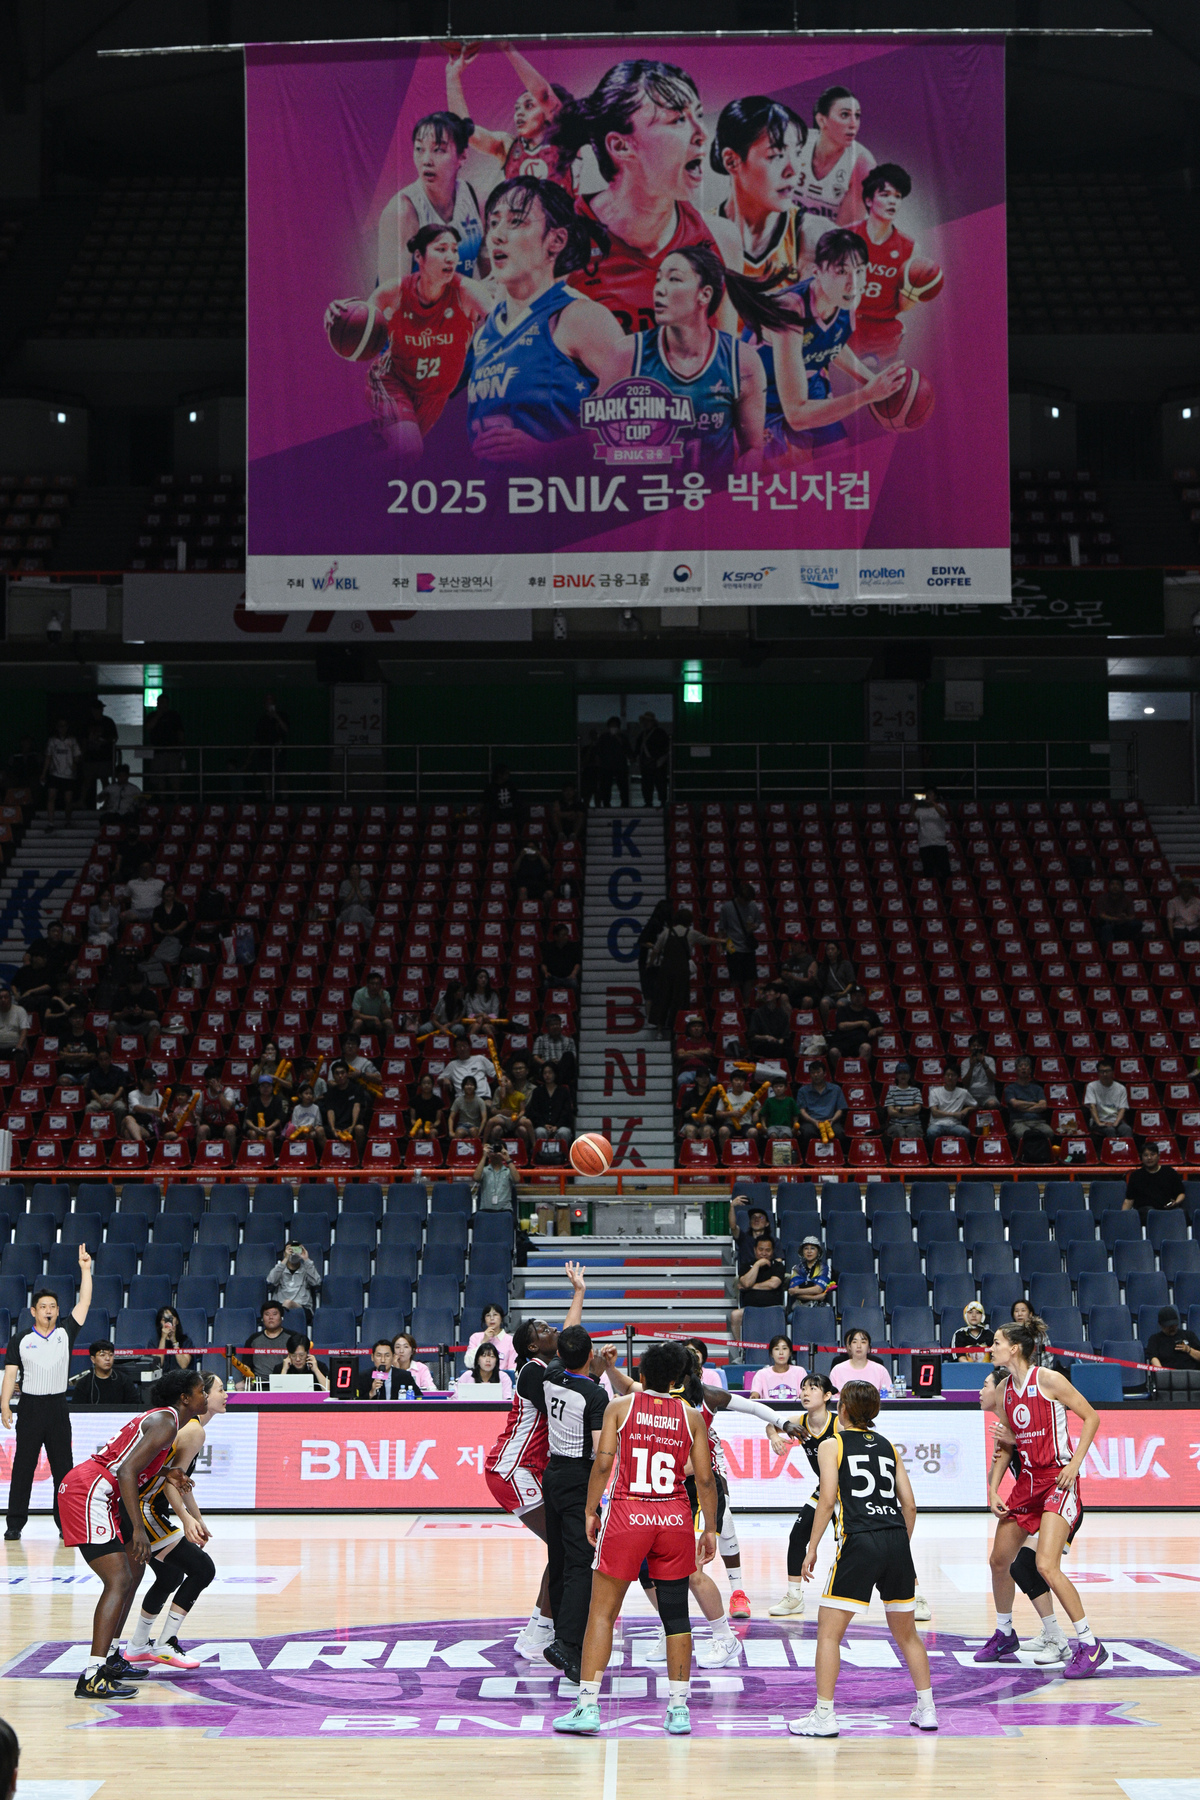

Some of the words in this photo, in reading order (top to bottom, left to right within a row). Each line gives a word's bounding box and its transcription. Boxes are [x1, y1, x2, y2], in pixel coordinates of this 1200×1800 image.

[404, 328, 454, 349] FUJITSU
[415, 356, 441, 380] 52
[475, 362, 505, 380] WOORI
[626, 386, 651, 396] 2025
[584, 399, 628, 424] PARK
[629, 397, 691, 422] SHIN-JA
[625, 425, 651, 440] CUP
[613, 449, 643, 461] BNK
[386, 480, 488, 514] 2025
[508, 475, 630, 514] BNK
[637, 472, 712, 512] 금융
[727, 470, 871, 512] 박신자컵
[722, 571, 763, 582] KSPO
[800, 567, 839, 575] POCARI
[859, 567, 905, 578] molten
[931, 566, 966, 575] EDIYA
[287, 578, 305, 588] 주최
[391, 577, 410, 588] 주관
[438, 576, 493, 588] 부산광역시
[528, 576, 546, 587] 후원
[553, 574, 596, 588] BNK
[598, 573, 651, 587] 금융그룹
[926, 577, 972, 586] COFFEE
[337, 714, 380, 730] 2-12
[872, 711, 916, 727] 2-13
[608, 819, 643, 963] KCC
[602, 987, 647, 1168] BNK
[336, 1366, 352, 1388] 0
[919, 1364, 934, 1387] 0
[551, 1397, 566, 1421] 27
[636, 1411, 653, 1427] OMA
[653, 1415, 680, 1431] GIRALT
[629, 1432, 642, 1441] AIR
[643, 1432, 684, 1448] HORIZONT
[300, 1440, 439, 1480] BNK
[716, 1439, 804, 1479] NK
[1076, 1437, 1171, 1479] NK
[629, 1447, 676, 1494] 16
[847, 1454, 895, 1499] 55
[865, 1502, 897, 1516] Sara
[629, 1513, 684, 1527] SOMMOS
